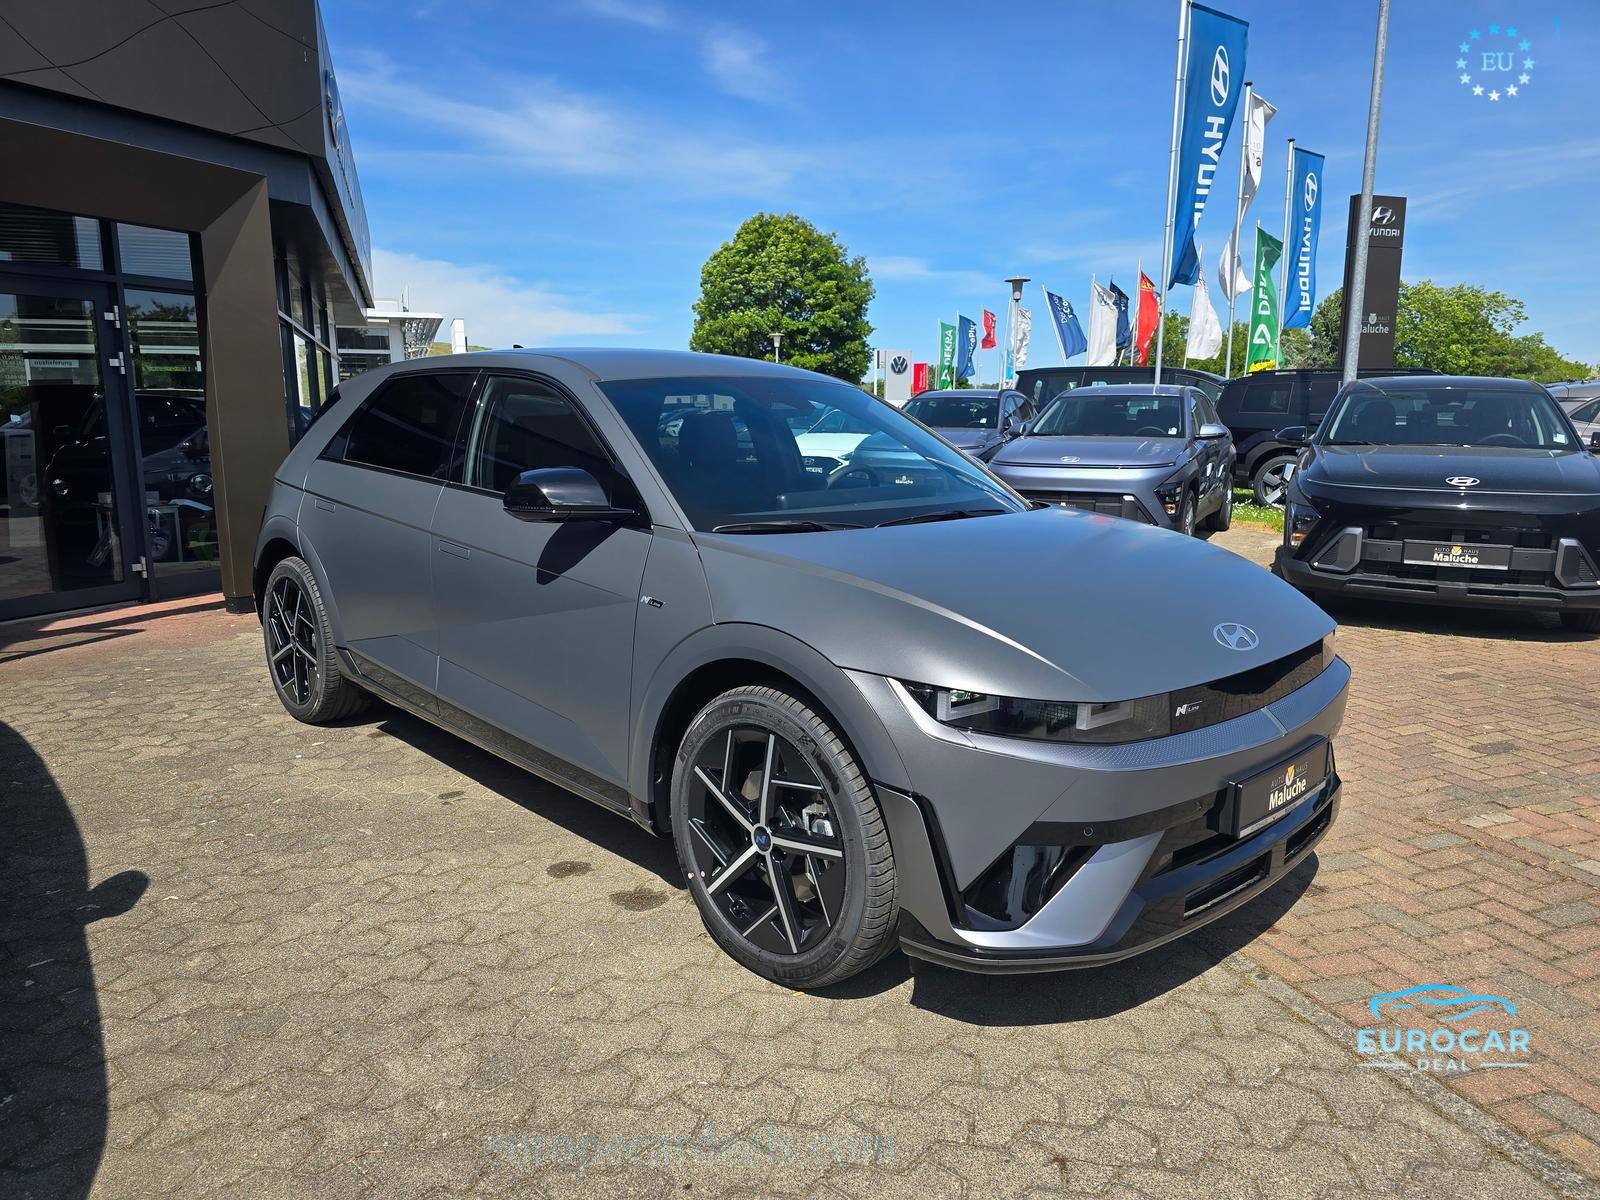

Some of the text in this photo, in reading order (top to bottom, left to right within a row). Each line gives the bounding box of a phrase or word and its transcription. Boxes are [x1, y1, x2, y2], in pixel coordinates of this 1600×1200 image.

[1369, 228, 1400, 237] YUNDAI
[1298, 217, 1312, 311] HYUNDAI
[1360, 324, 1389, 334] aluche
[944, 328, 953, 365] DEKRA
[1433, 552, 1479, 564] Maluche
[1268, 778, 1307, 810] Maluche
